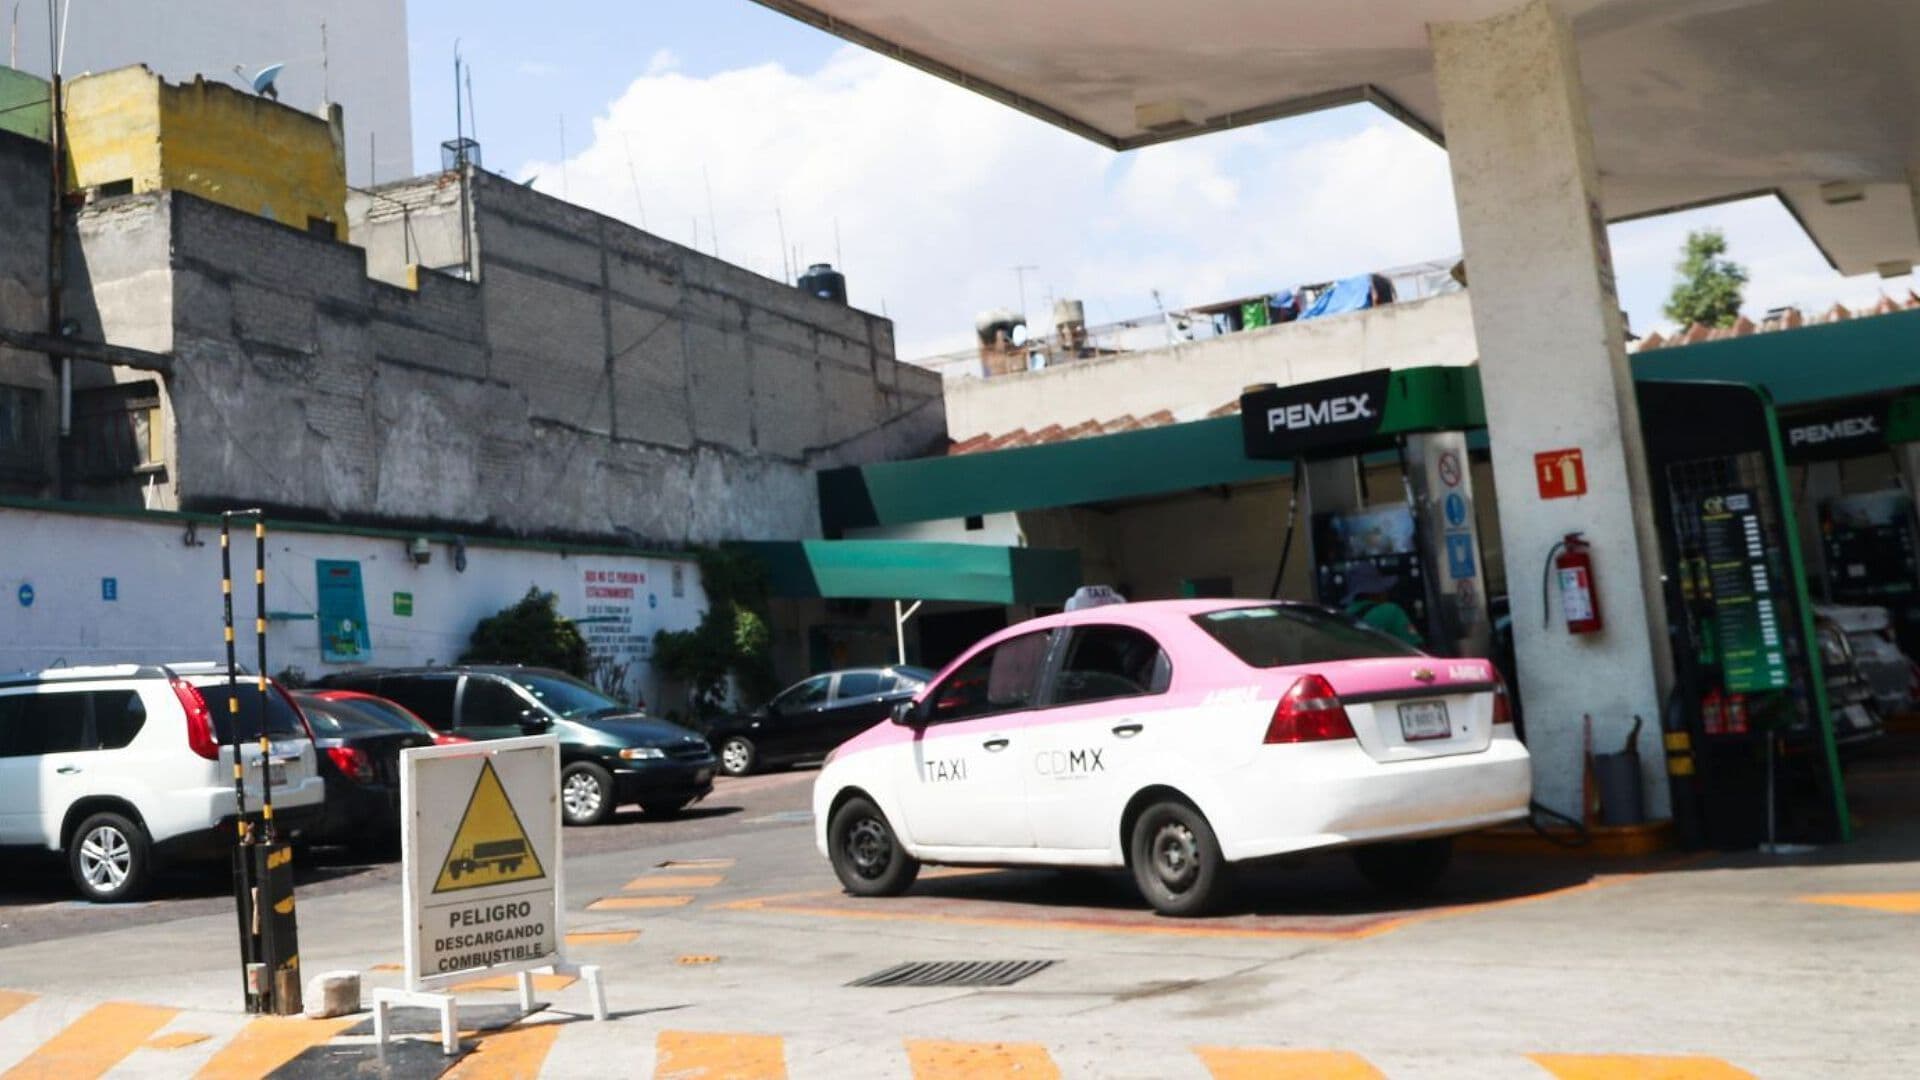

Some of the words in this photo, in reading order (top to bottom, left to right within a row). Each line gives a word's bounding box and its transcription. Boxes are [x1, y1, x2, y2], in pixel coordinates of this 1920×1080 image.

[1267, 393, 1372, 433] PEMEX
[1789, 415, 1878, 446] PEMEX
[1085, 587, 1112, 599] TAXI
[925, 758, 967, 783] TAXI
[1035, 748, 1105, 776] CDMX
[449, 901, 531, 929] PELIGRO
[434, 923, 544, 952] DESCARGANDO
[438, 943, 543, 971] COMBUSTIBLE
